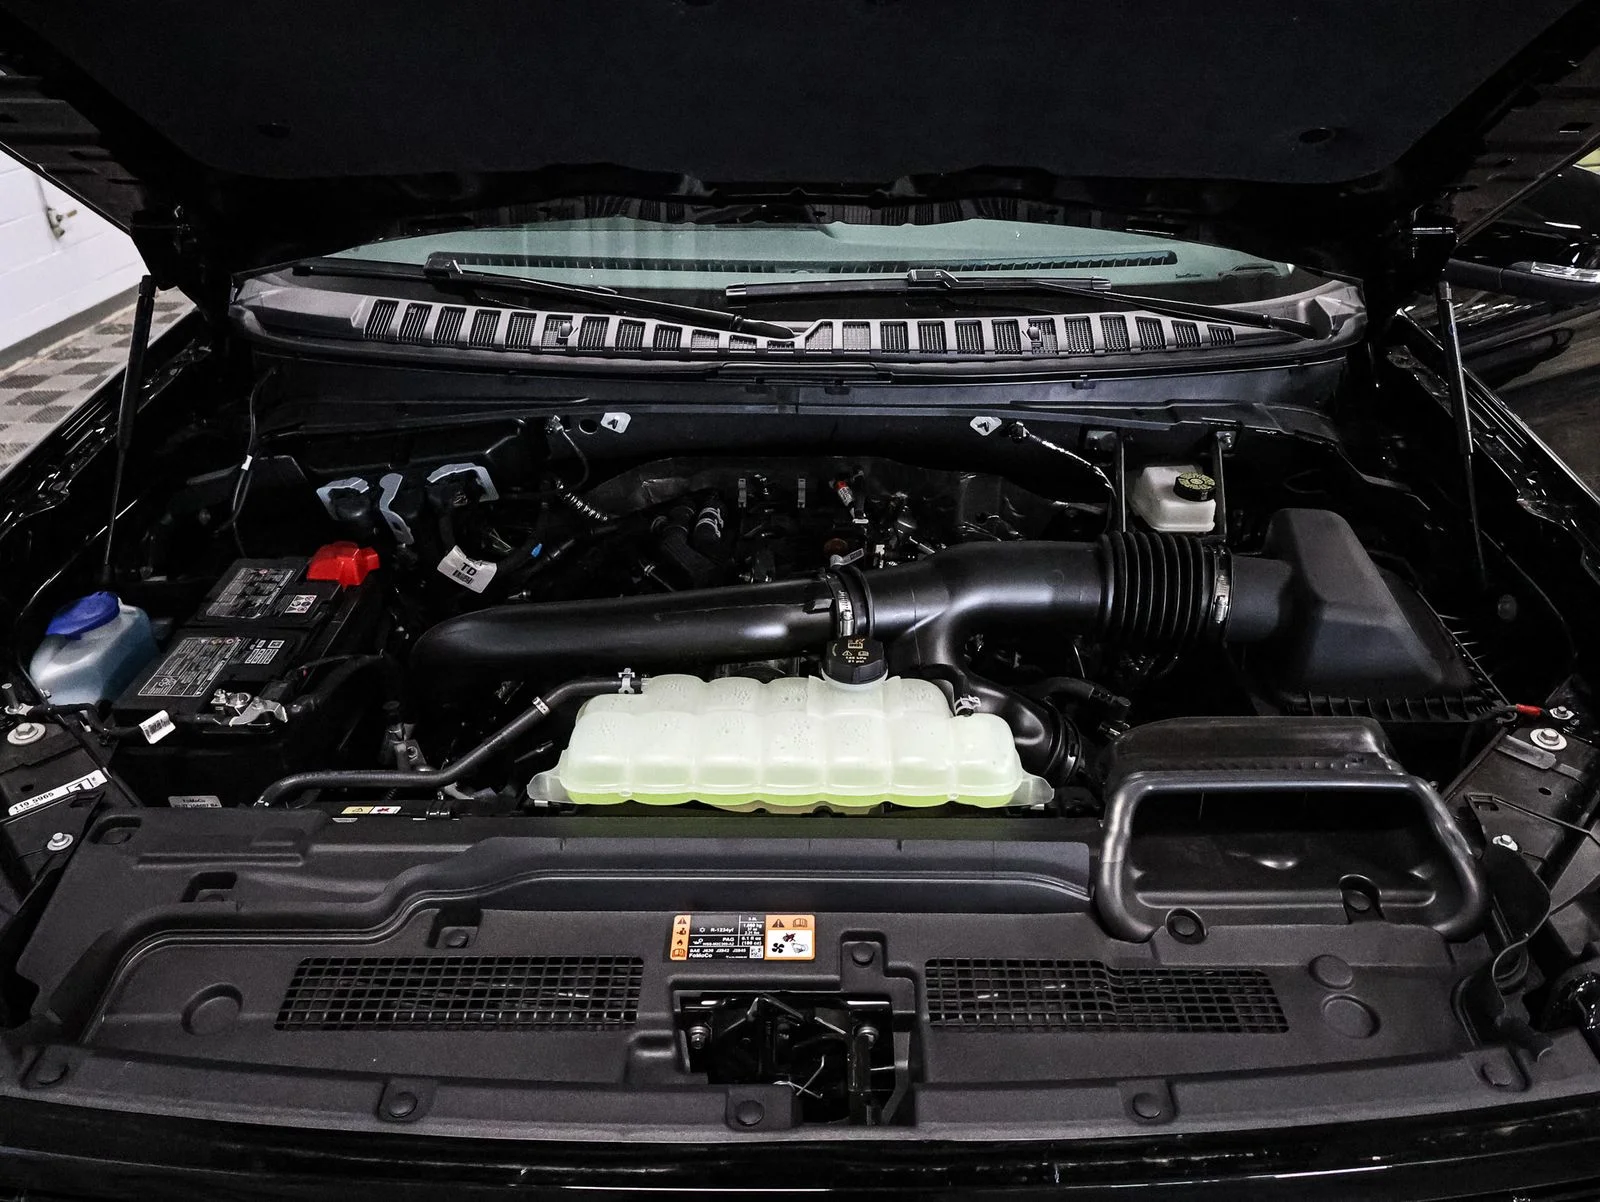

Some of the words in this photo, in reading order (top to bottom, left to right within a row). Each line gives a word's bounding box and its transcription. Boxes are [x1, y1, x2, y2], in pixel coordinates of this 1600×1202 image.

[461, 562, 477, 576] TD
[14, 802, 30, 810] 119
[32, 792, 55, 803] 5965
